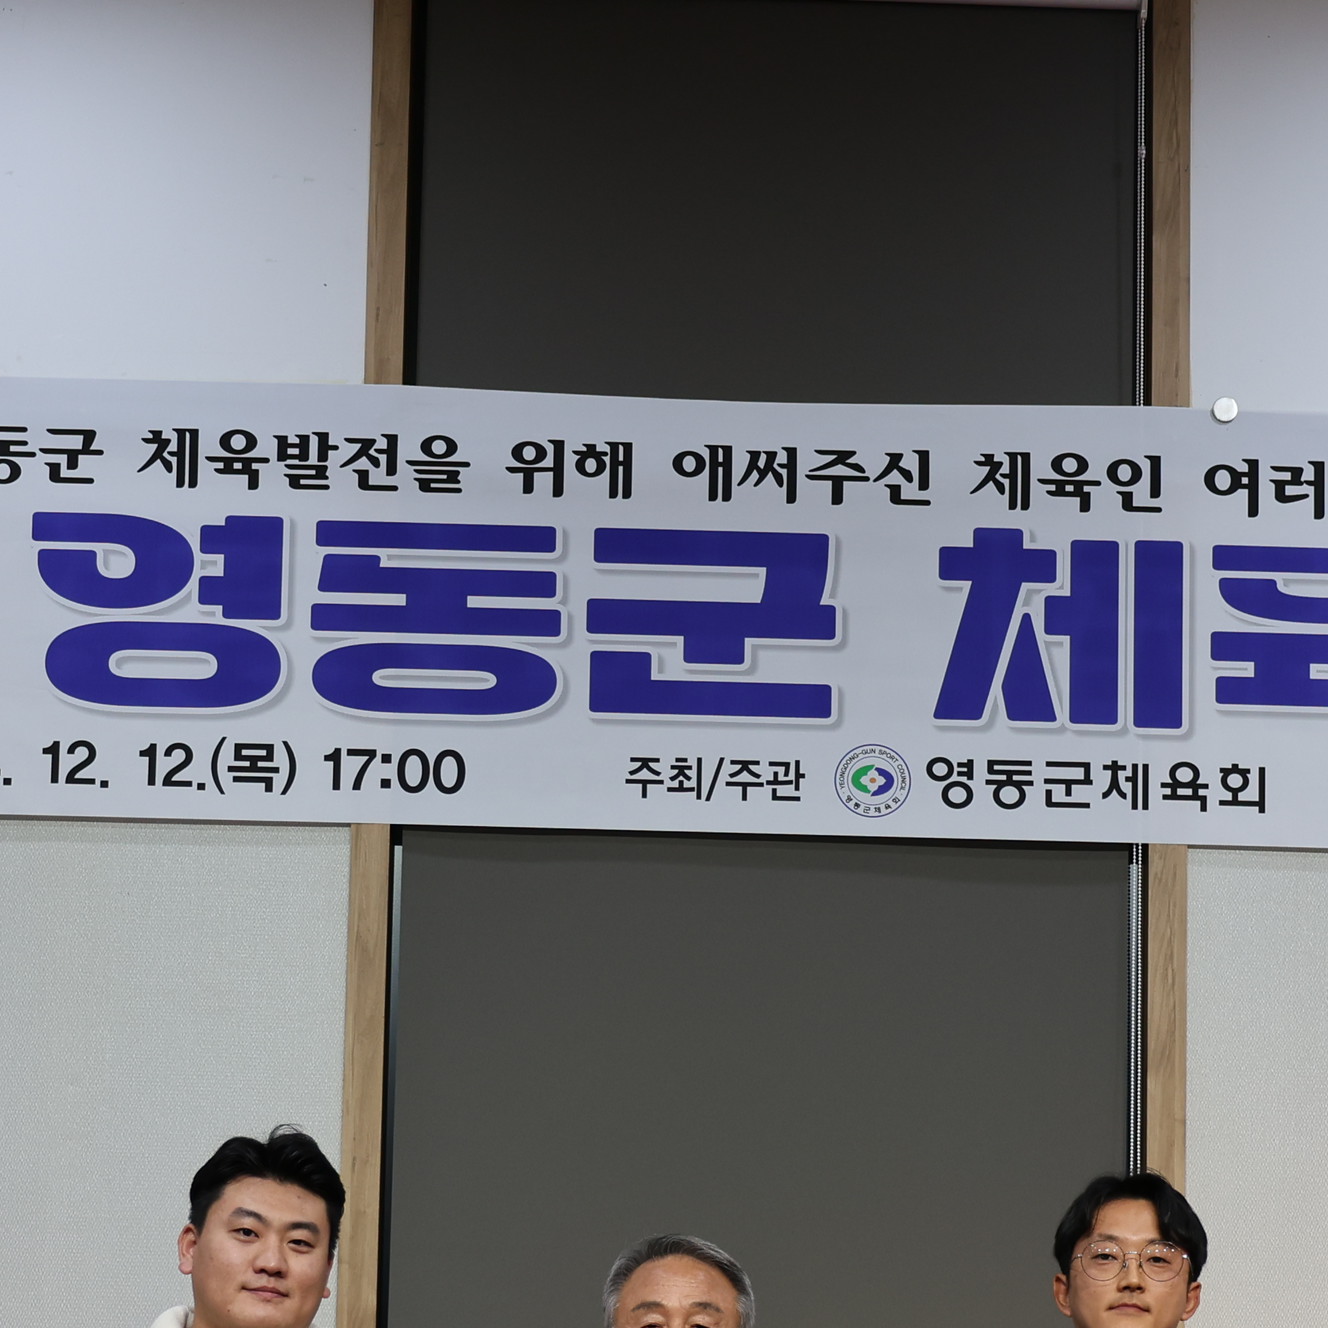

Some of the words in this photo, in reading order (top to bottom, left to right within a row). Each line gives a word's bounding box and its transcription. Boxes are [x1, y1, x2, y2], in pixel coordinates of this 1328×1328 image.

[136, 428, 471, 494] 체육발전을
[505, 439, 633, 500] 위해
[671, 444, 932, 507] 애써주신
[969, 451, 1163, 514] 체육인
[33, 512, 836, 718] 영동군
[42, 739, 109, 789] 12.
[139, 736, 297, 796] 12.(목)
[323, 747, 466, 795] 17:00
[625, 756, 806, 802] 주최/주관
[925, 756, 1266, 814] 영동군체육회
[878, 749, 899, 764] SPORT
[897, 764, 907, 791] COUNCIL
[845, 795, 901, 814] 영동군체육회
